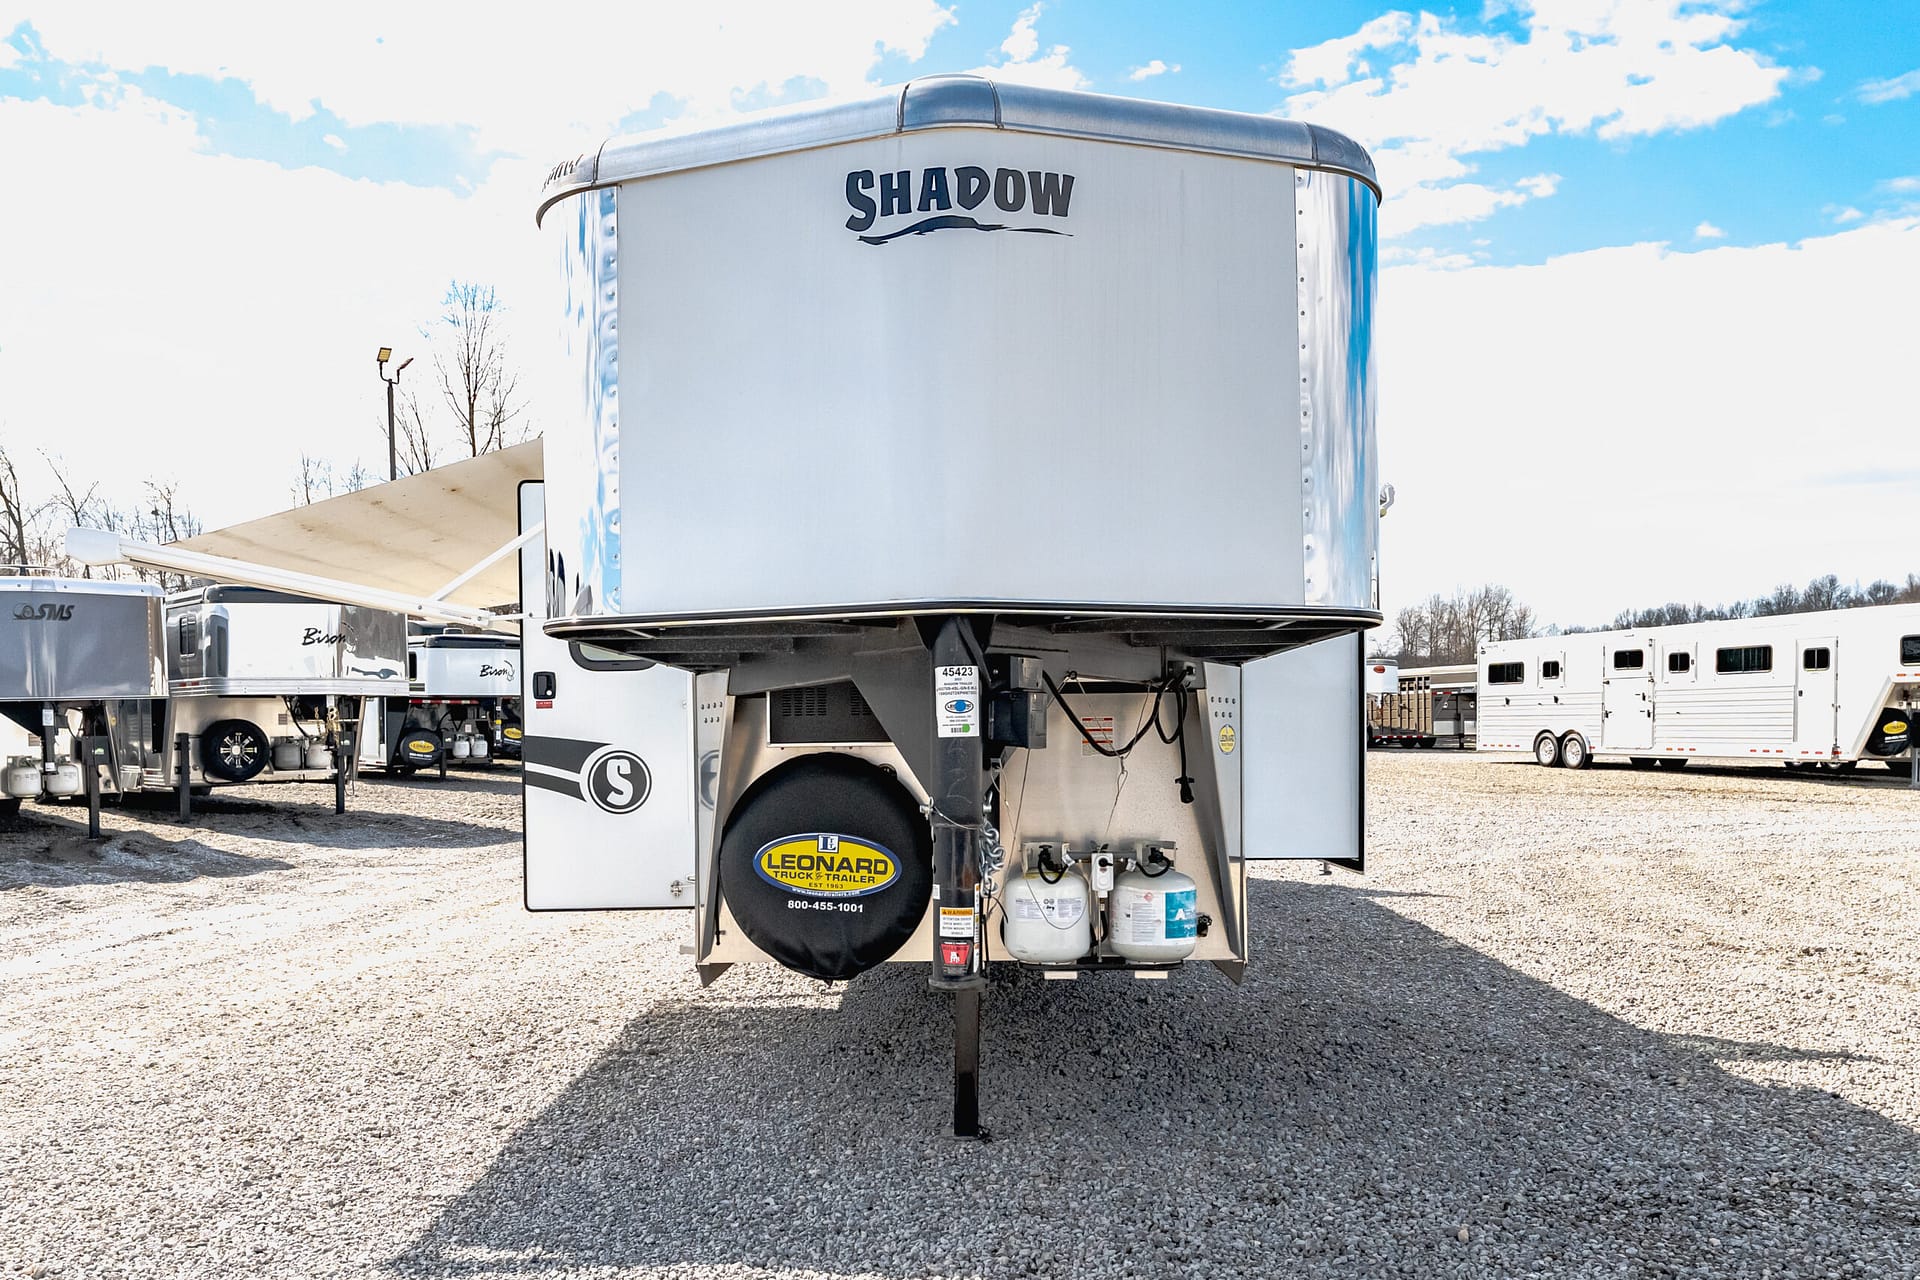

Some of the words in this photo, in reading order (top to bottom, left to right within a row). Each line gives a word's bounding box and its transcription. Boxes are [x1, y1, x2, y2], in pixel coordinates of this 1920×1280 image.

[845, 166, 1075, 232] SHADOW
[38, 603, 75, 621] SMS
[302, 627, 346, 646] Bison
[480, 664, 508, 677] Bison
[942, 667, 973, 677] 45423
[606, 758, 634, 806] S
[767, 853, 888, 875] LEONARD
[773, 870, 813, 880] TRUCK
[825, 873, 875, 884] TRAILER
[787, 900, 863, 913] 800-455-1001
